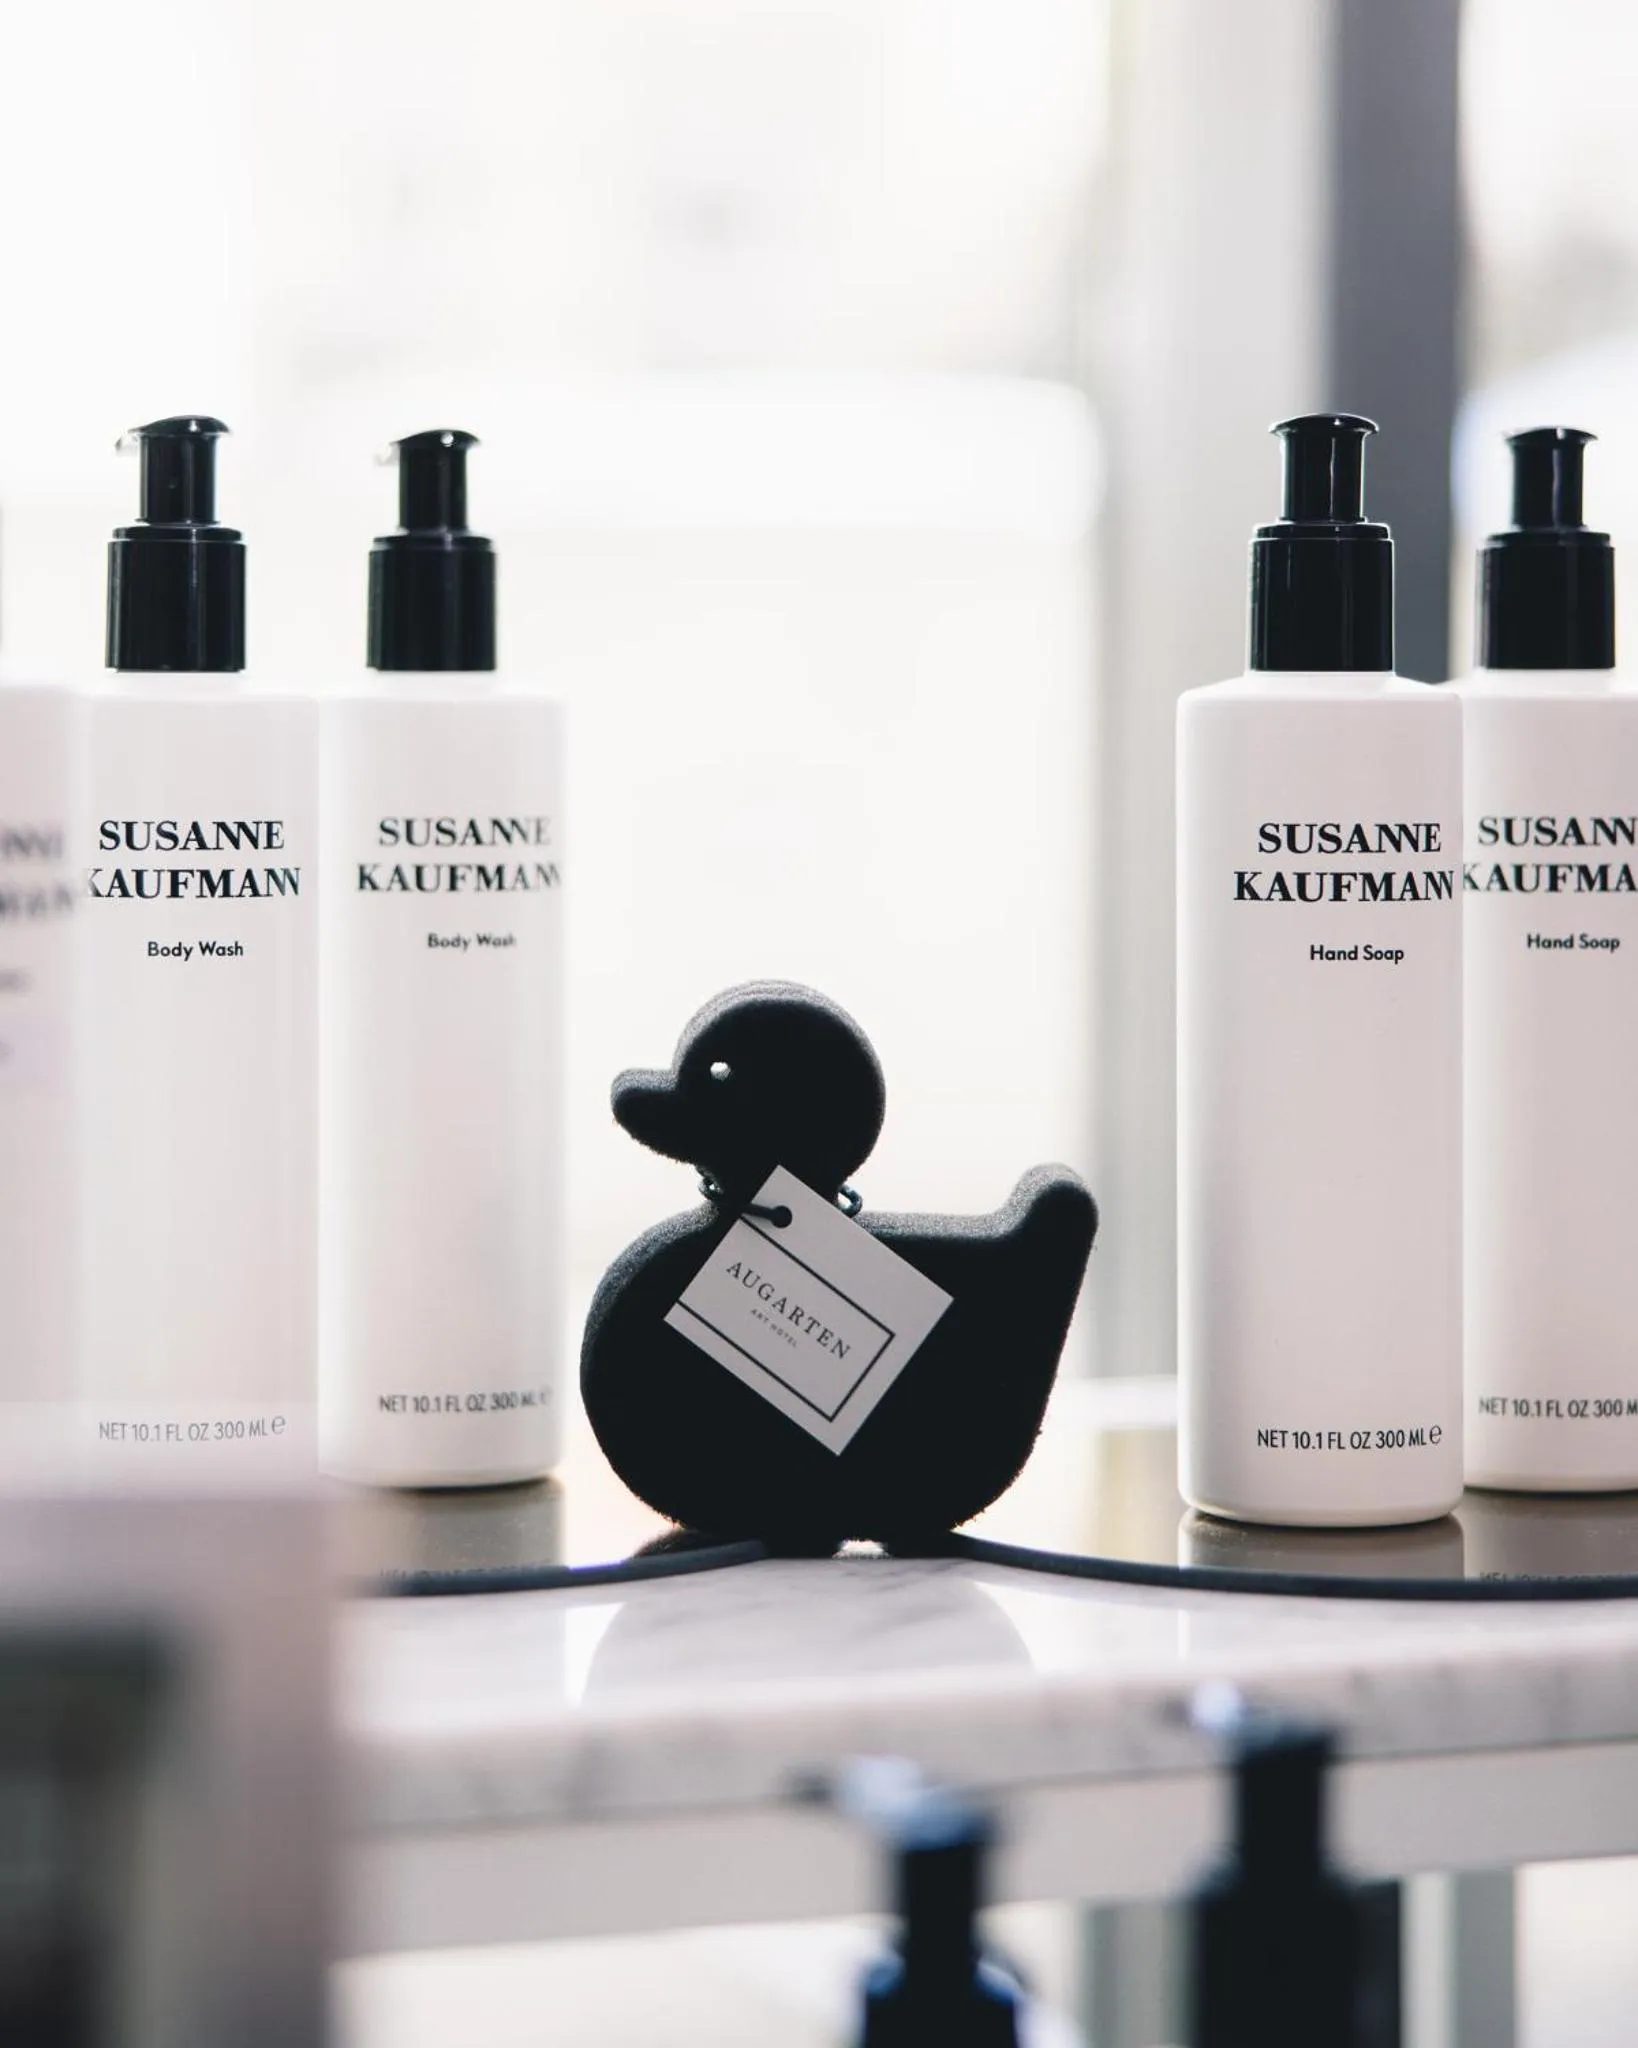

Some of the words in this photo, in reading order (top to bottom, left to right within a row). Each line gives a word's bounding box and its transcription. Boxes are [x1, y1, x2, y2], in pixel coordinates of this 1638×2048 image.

[99, 820, 285, 851] SUSANNE
[378, 817, 551, 848] SUSANNE
[1258, 823, 1442, 853] SUSANNE
[1233, 870, 1455, 903] KAUFMANN
[147, 941, 193, 961] Body
[199, 941, 244, 957] Wash
[427, 932, 471, 953] Body
[476, 932, 517, 948] Wash
[1527, 933, 1575, 950] Hand
[1579, 933, 1620, 953] Soap
[1310, 944, 1358, 962] Hand
[1362, 945, 1405, 965] Soap
[725, 1261, 851, 1359] AUGARTEN
[379, 1393, 408, 1413] NET
[413, 1395, 441, 1413] 10.1
[445, 1394, 461, 1412] FL
[1478, 1396, 1508, 1415] NET
[1512, 1399, 1542, 1417] 10.1
[1546, 1399, 1564, 1418] FL
[1568, 1399, 1589, 1418] OZ
[1593, 1399, 1623, 1417] 300
[99, 1421, 128, 1440] NET
[131, 1423, 161, 1442] 10.1
[165, 1423, 183, 1442] FL
[188, 1422, 209, 1441] OZ
[213, 1420, 245, 1440] 300
[1257, 1428, 1289, 1448] NET
[1291, 1430, 1323, 1450] 10.1
[1328, 1431, 1346, 1450] FL
[1350, 1431, 1371, 1450] OZ
[1375, 1429, 1406, 1449] 300
